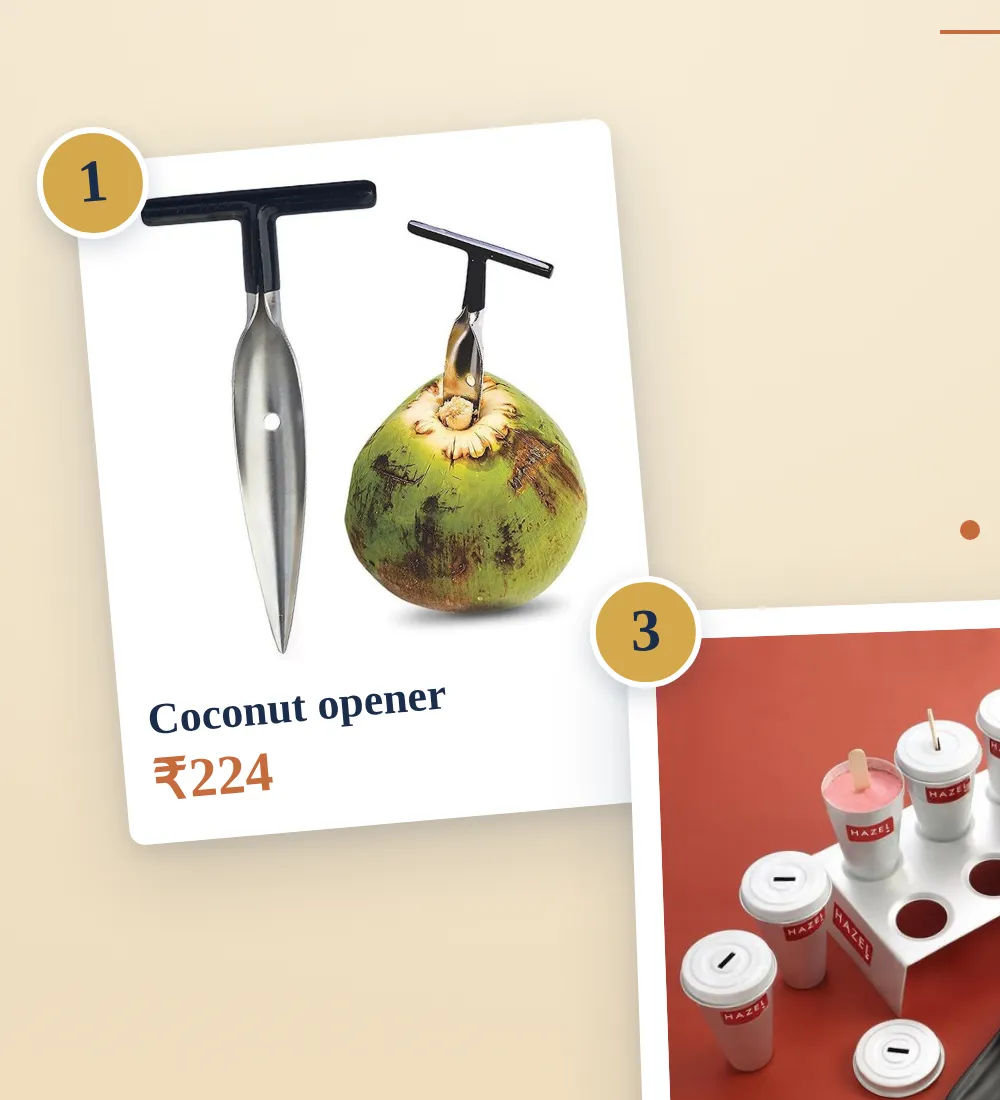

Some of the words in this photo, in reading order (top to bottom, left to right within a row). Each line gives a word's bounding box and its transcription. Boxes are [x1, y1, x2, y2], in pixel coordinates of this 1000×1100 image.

[80, 160, 107, 203] 1
[632, 610, 660, 652] 3
[149, 695, 308, 734] Coconut
[319, 686, 446, 728] opener
[153, 752, 274, 800] ₹224
